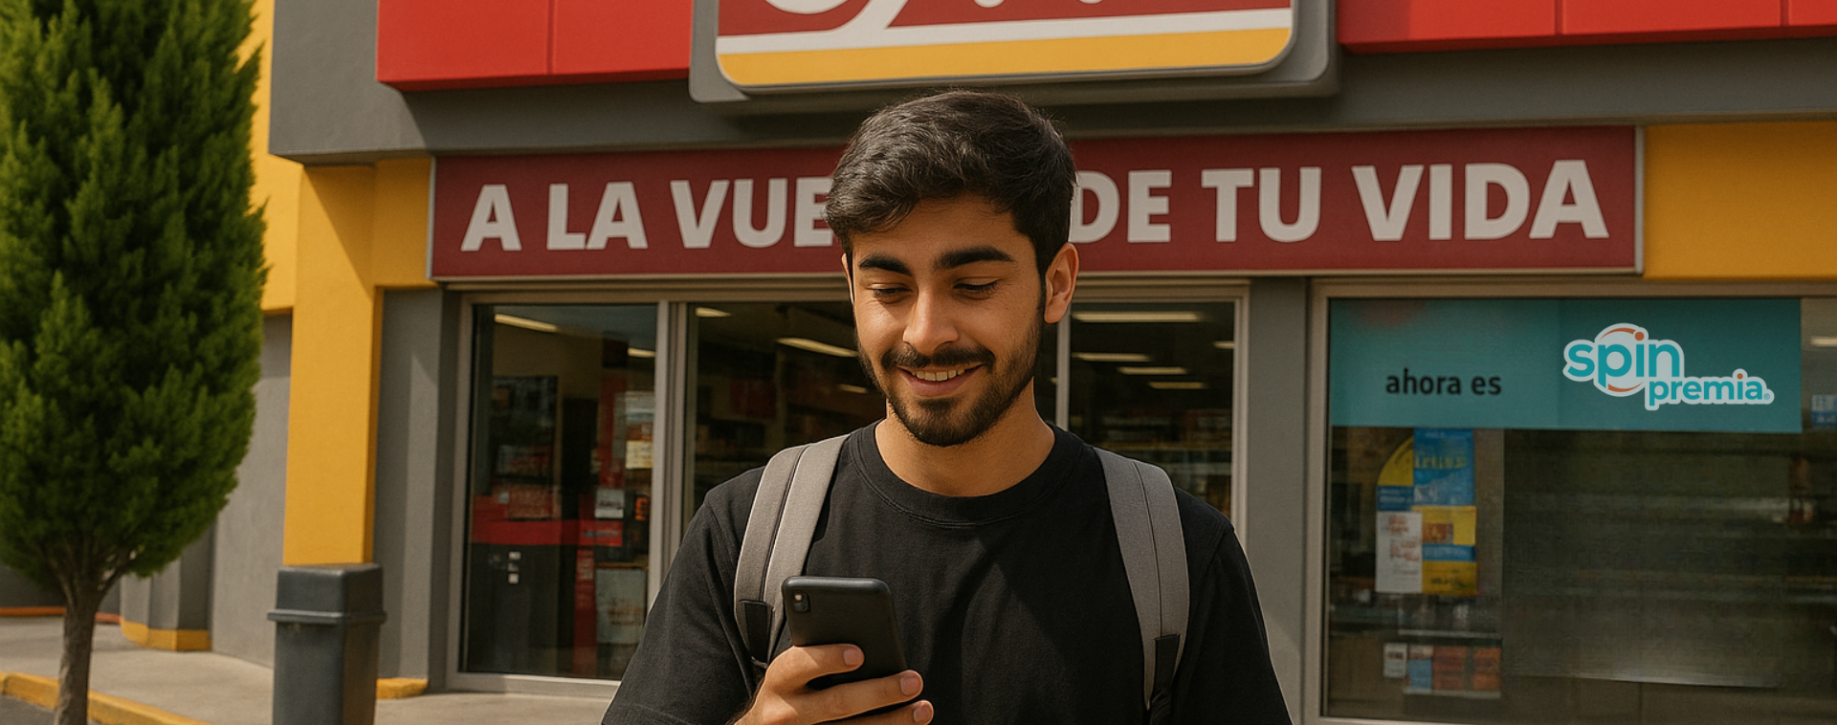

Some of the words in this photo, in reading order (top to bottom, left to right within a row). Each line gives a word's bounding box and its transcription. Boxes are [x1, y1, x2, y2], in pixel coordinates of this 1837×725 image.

[461, 184, 522, 252] A
[546, 181, 648, 250] LA
[670, 177, 835, 248] VUE
[1068, 170, 1173, 243] DE
[1201, 167, 1322, 243] TU
[1351, 159, 1610, 241] VIDA
[1386, 368, 1461, 395] ahora
[1471, 376, 1502, 395] es
[1567, 330, 1680, 389] spin
